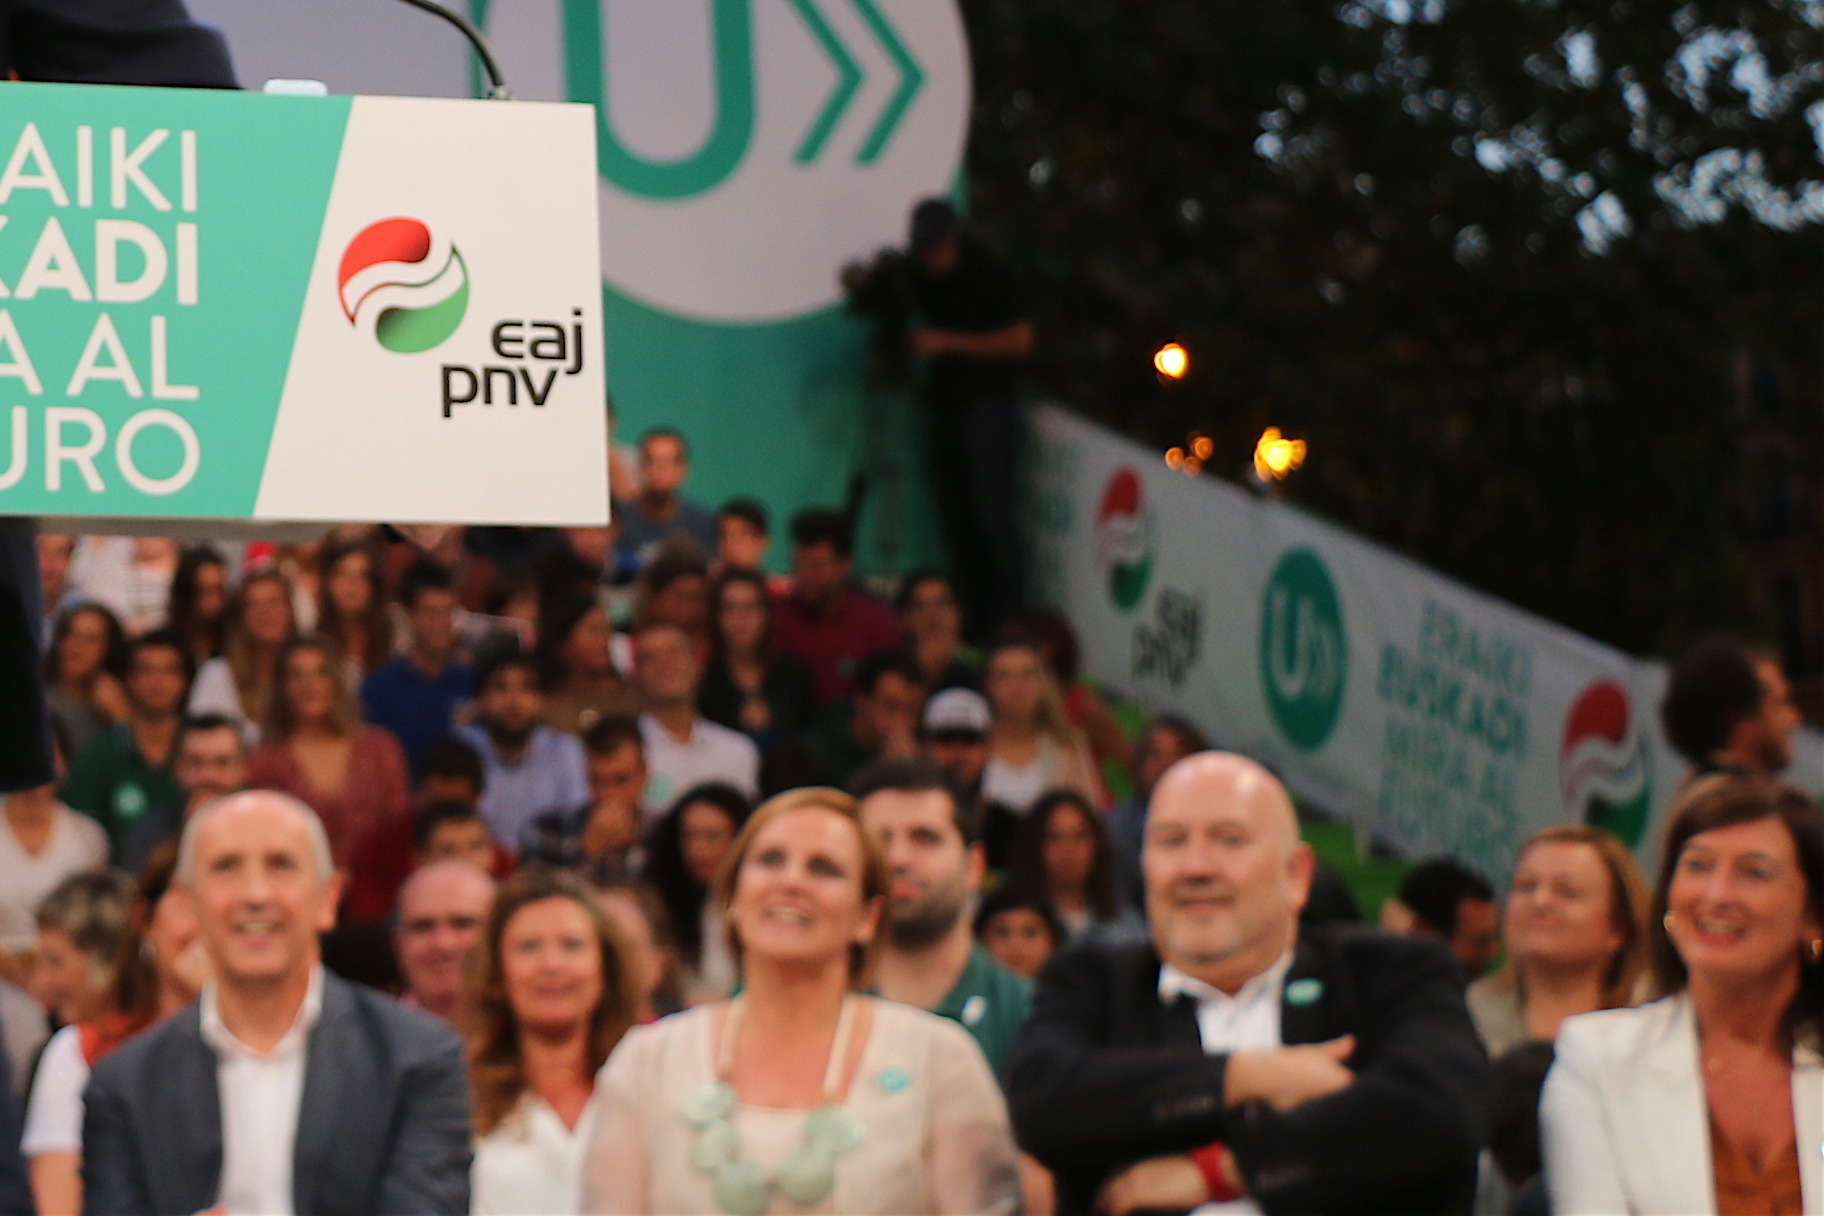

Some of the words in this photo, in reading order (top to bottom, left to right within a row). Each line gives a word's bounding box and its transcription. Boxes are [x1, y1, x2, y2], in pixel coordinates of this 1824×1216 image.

[67, 314, 199, 400] AL
[491, 307, 583, 375] eaj
[441, 364, 557, 418] pnv
